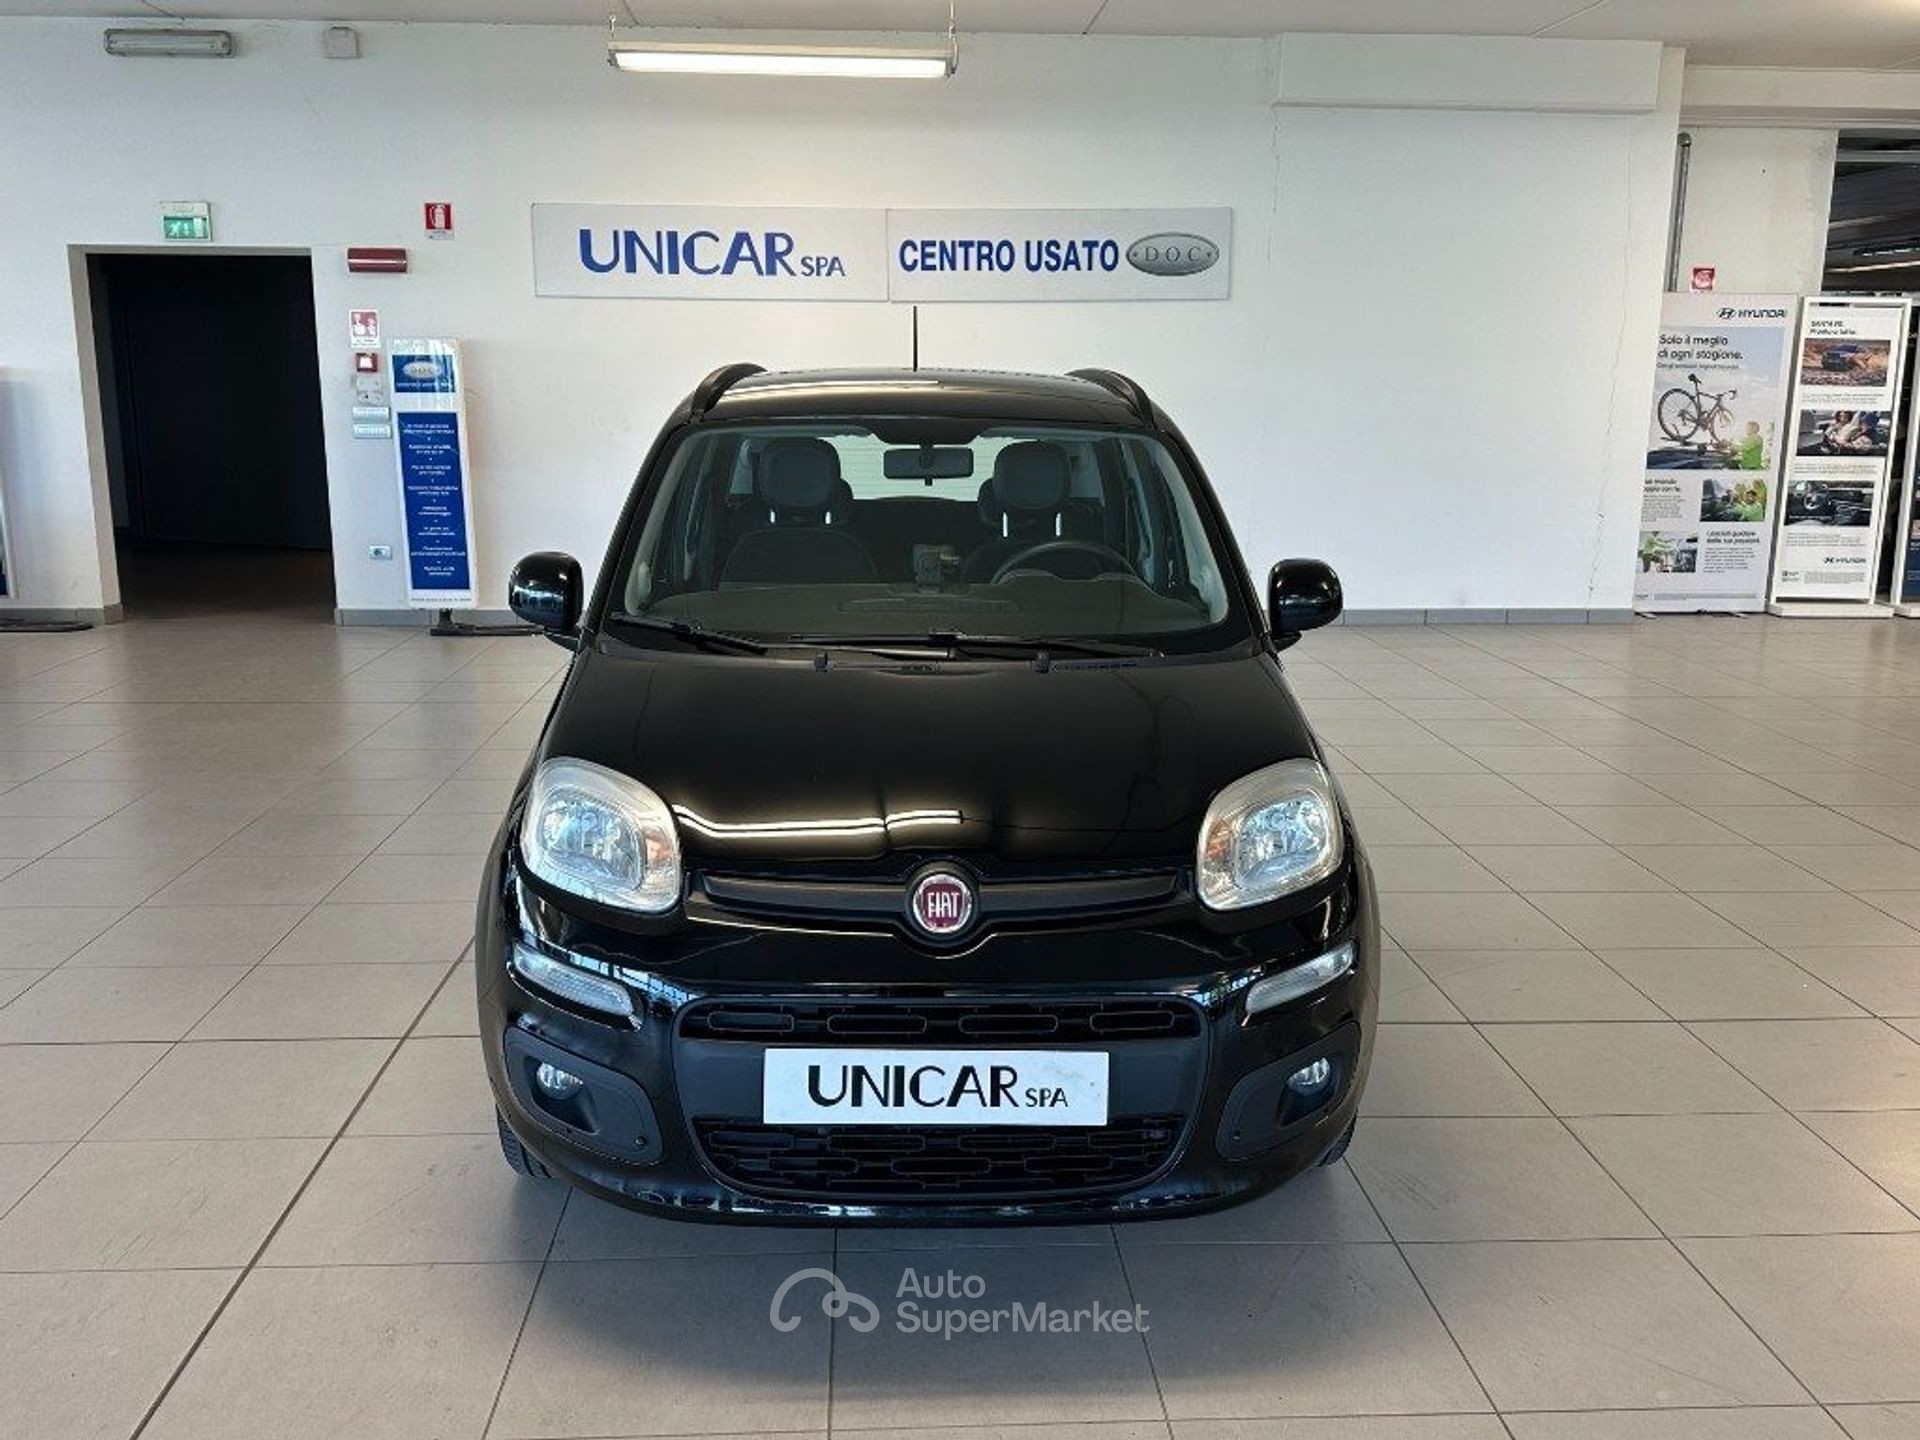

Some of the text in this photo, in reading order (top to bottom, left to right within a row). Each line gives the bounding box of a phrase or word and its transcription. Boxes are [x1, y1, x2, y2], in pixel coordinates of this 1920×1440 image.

[578, 228, 846, 278] UNICAR SPA
[899, 239, 1119, 273] CENTRO USATO
[1659, 333, 1729, 347] Solo il meglio
[1670, 348, 1693, 361] ogni
[1695, 349, 1744, 361] stagione.
[927, 890, 960, 918] FIAT
[807, 1064, 1069, 1108] UNICAR SPA
